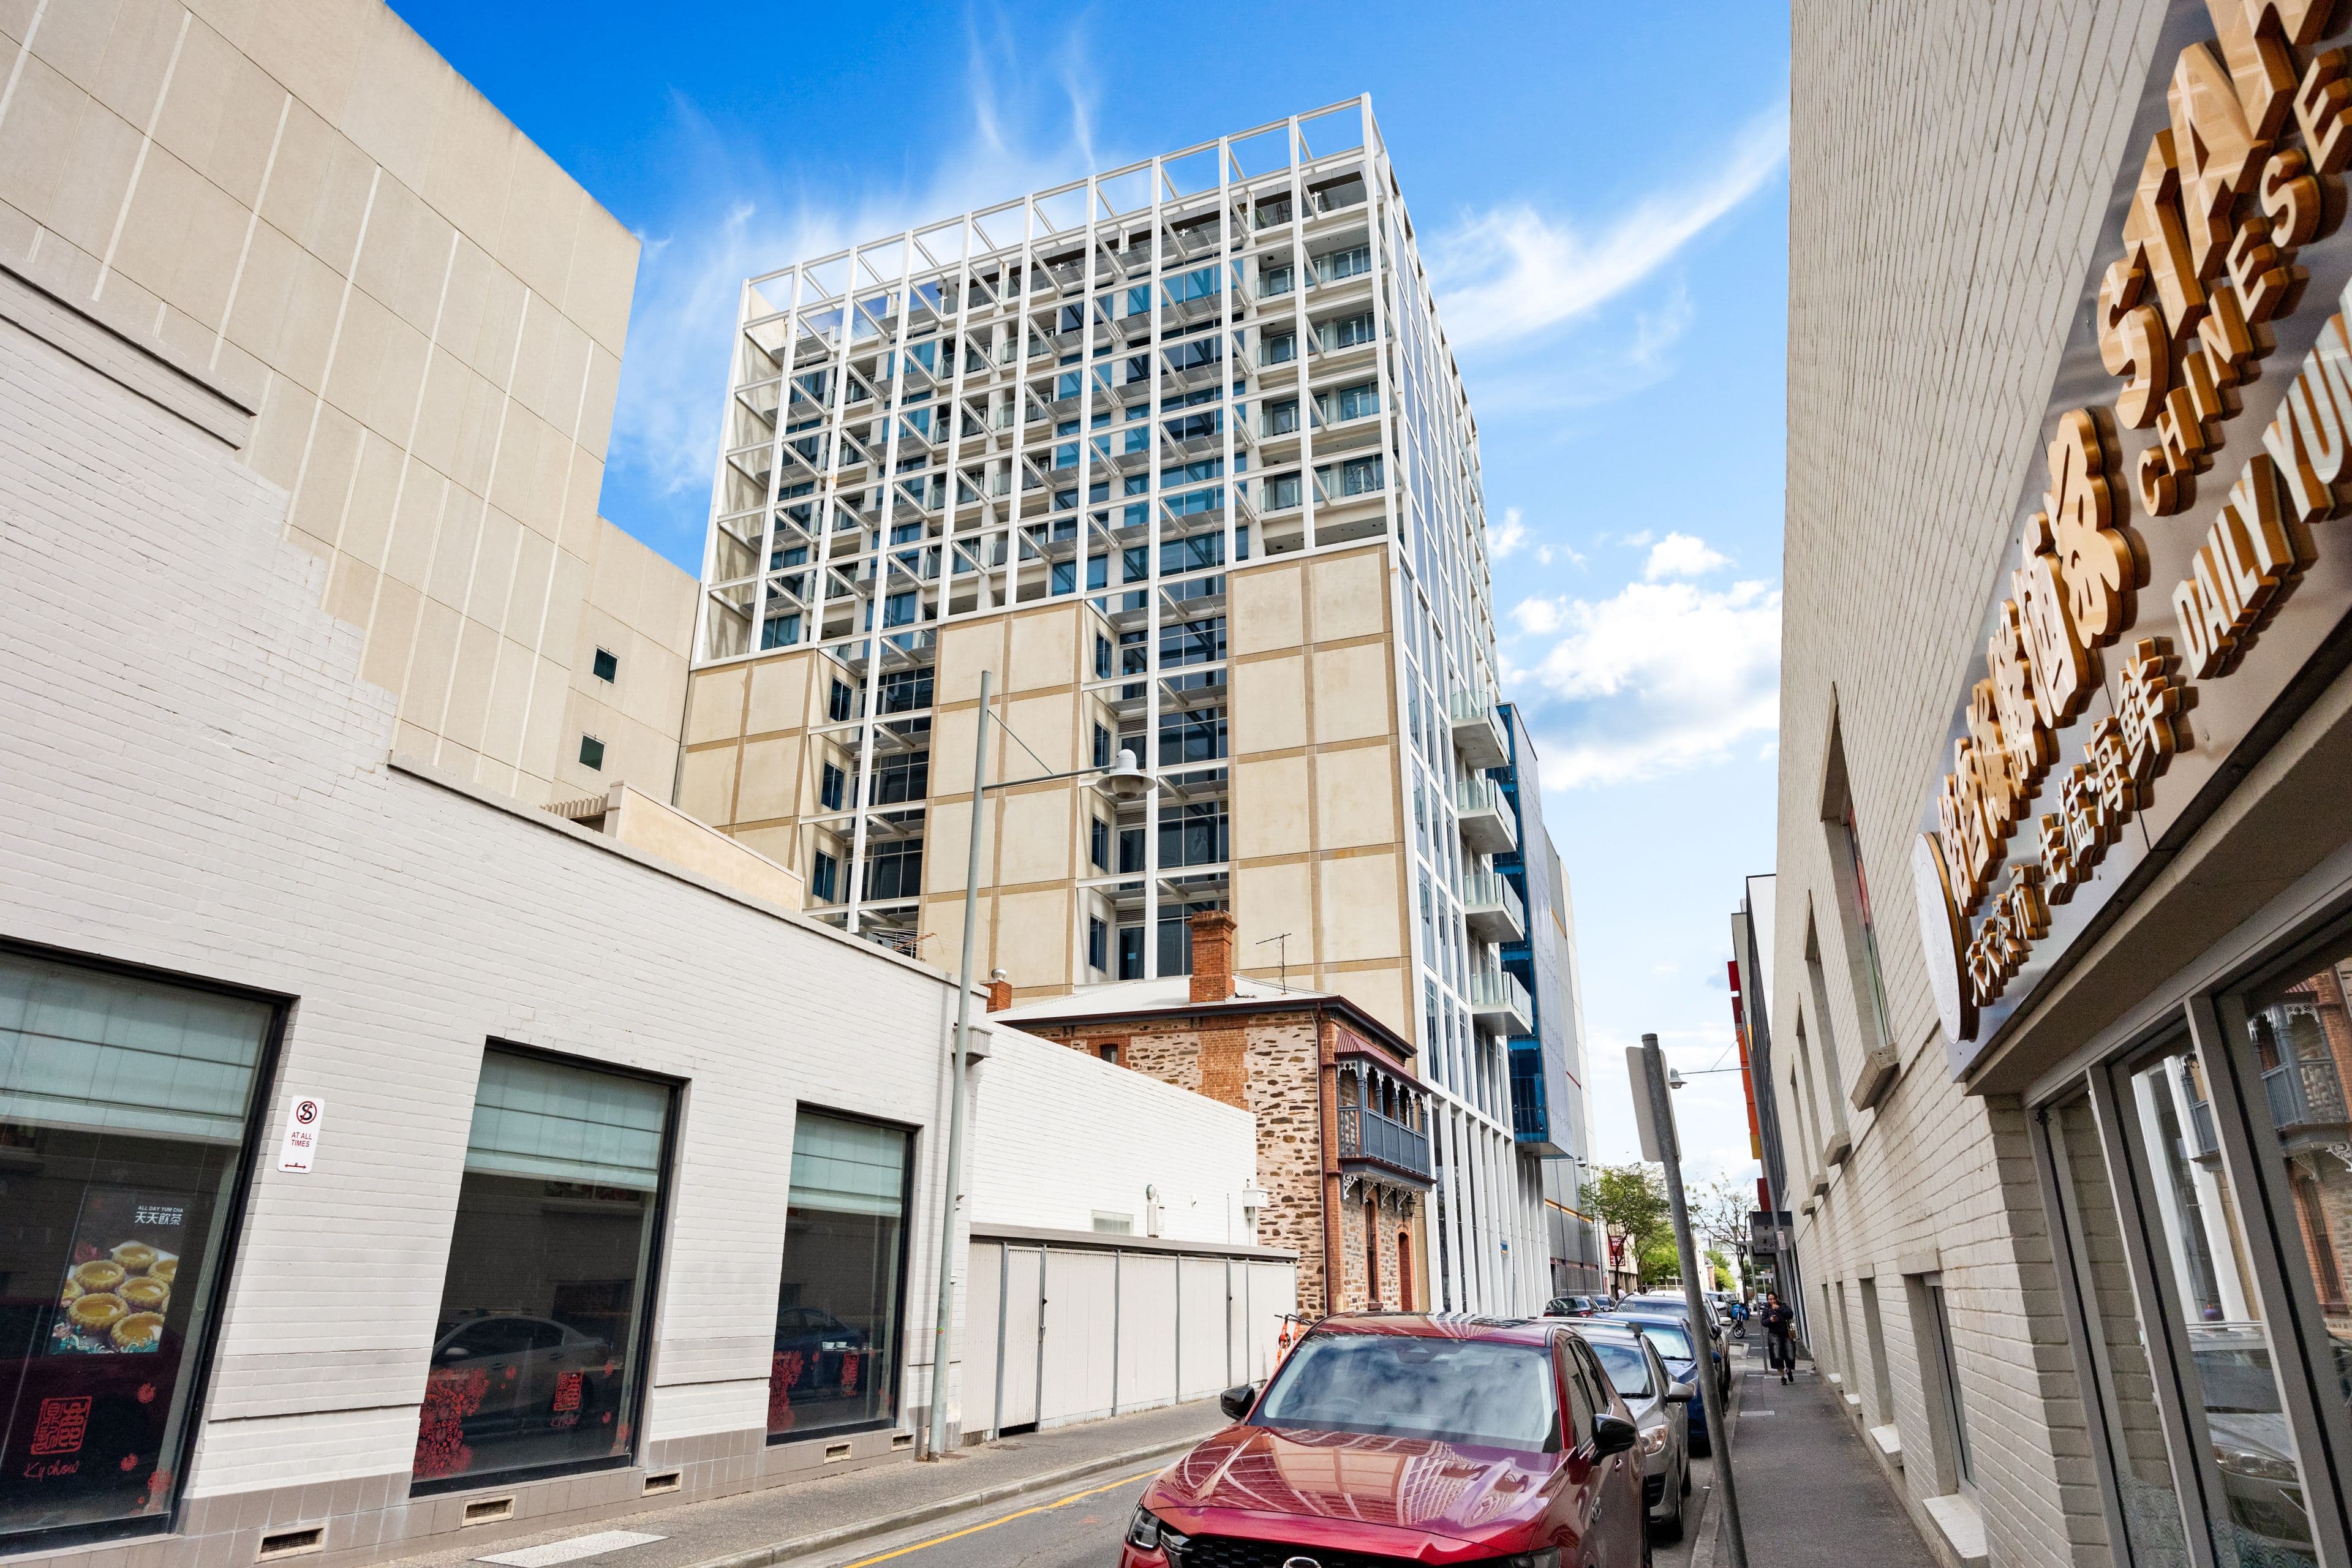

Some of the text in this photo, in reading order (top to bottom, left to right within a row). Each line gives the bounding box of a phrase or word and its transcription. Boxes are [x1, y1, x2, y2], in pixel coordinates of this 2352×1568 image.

[2137, 57, 2344, 516] CHINESE
[2172, 458, 2272, 679] DAILY
[135, 1212, 183, 1225] 天天飲茶
